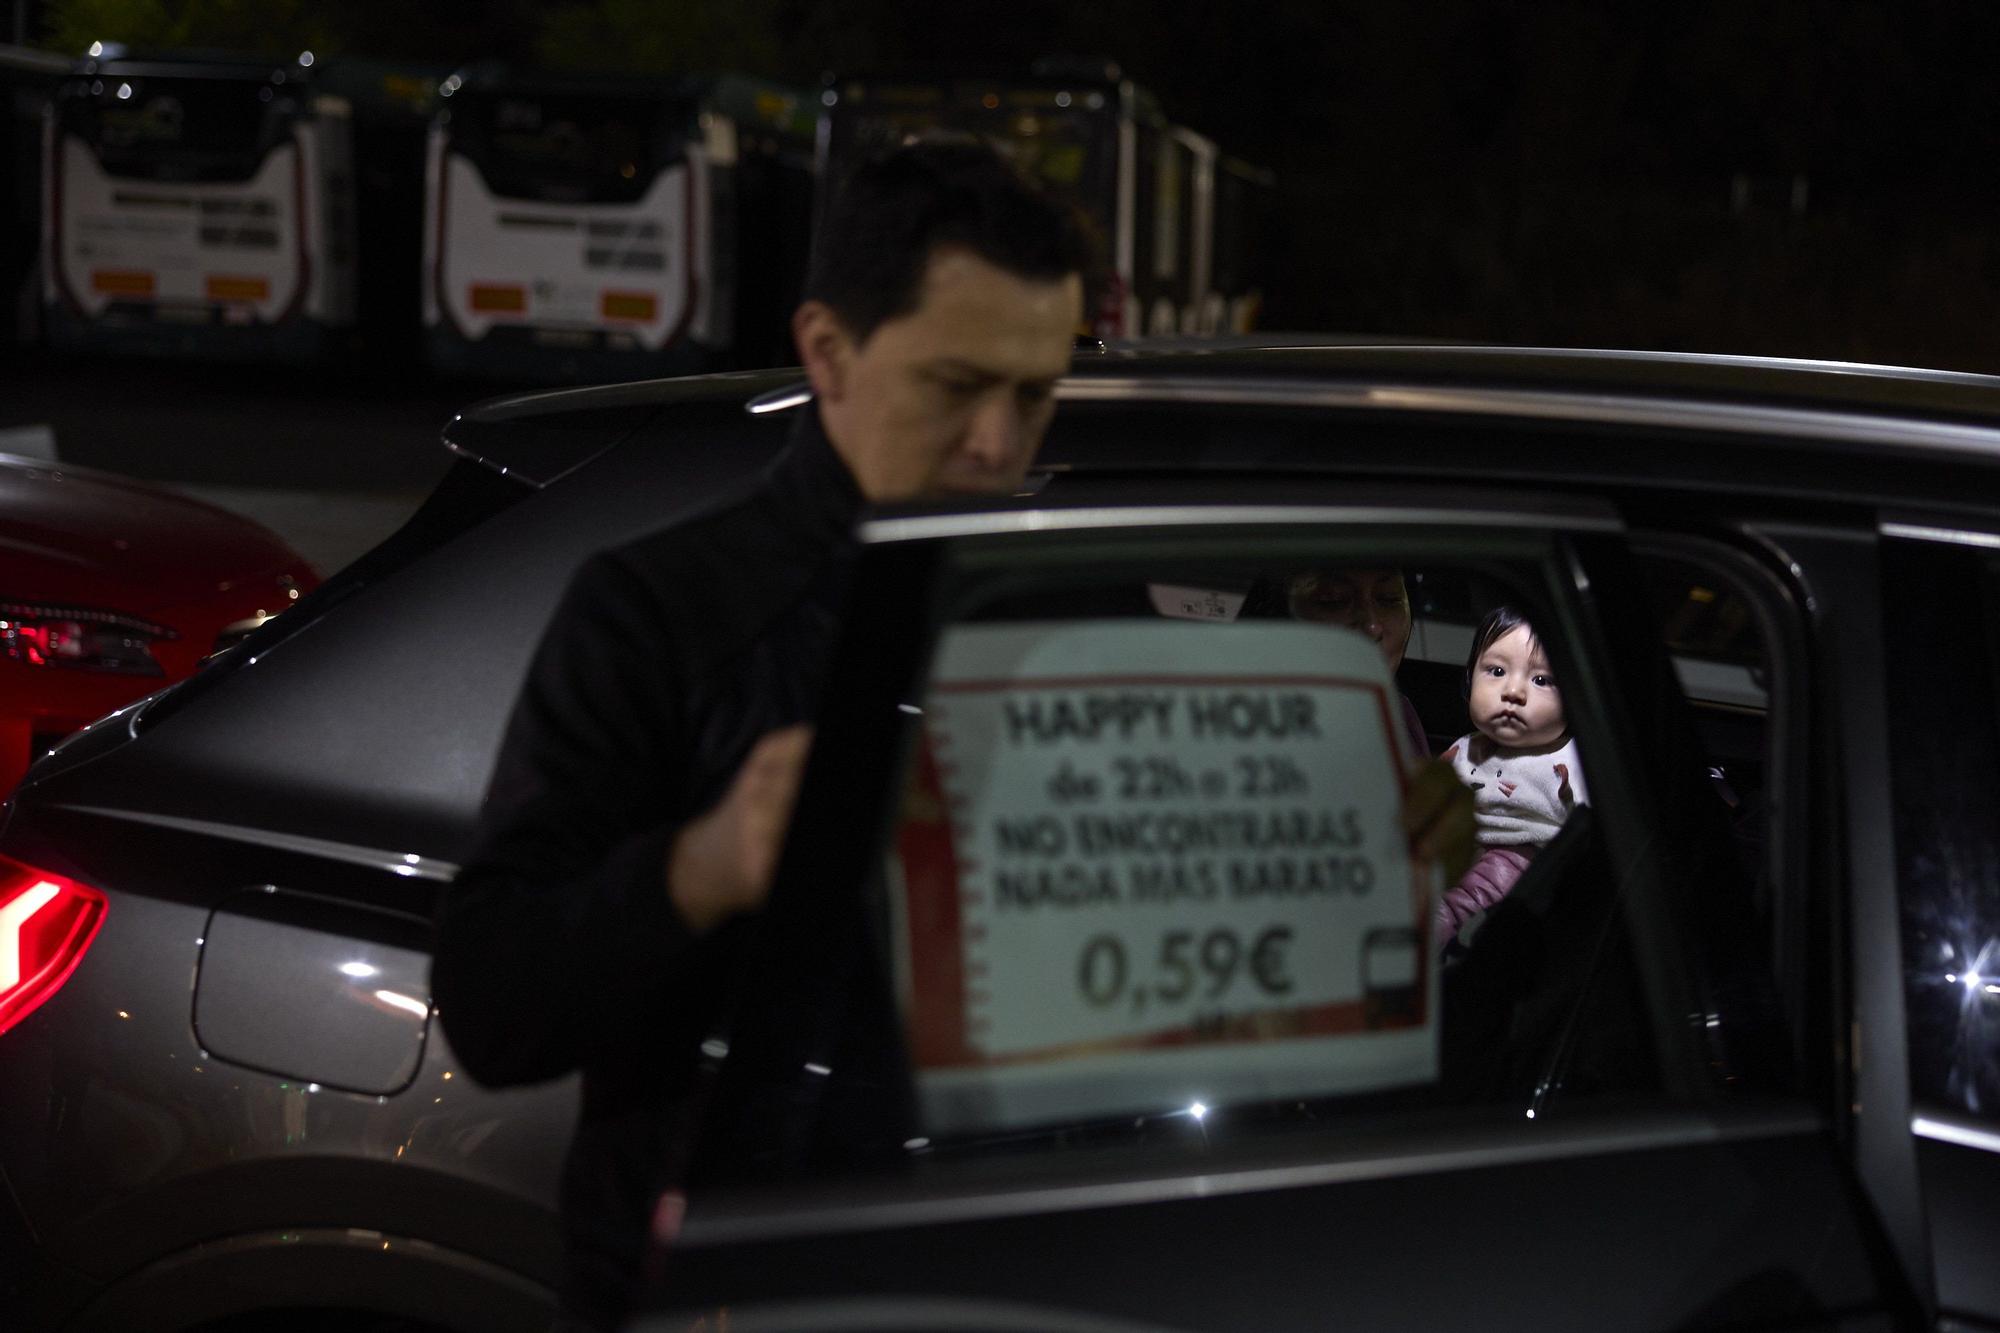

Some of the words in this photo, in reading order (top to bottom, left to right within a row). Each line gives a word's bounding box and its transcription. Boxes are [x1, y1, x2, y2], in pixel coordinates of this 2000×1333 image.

[1004, 696, 1175, 743] HAPPY
[1188, 695, 1323, 740] HOUR
[991, 816, 1067, 858] NO
[991, 866, 1120, 910] NADA
[1228, 857, 1376, 901] BARATO
[1076, 925, 1296, 1012] 0,59€
